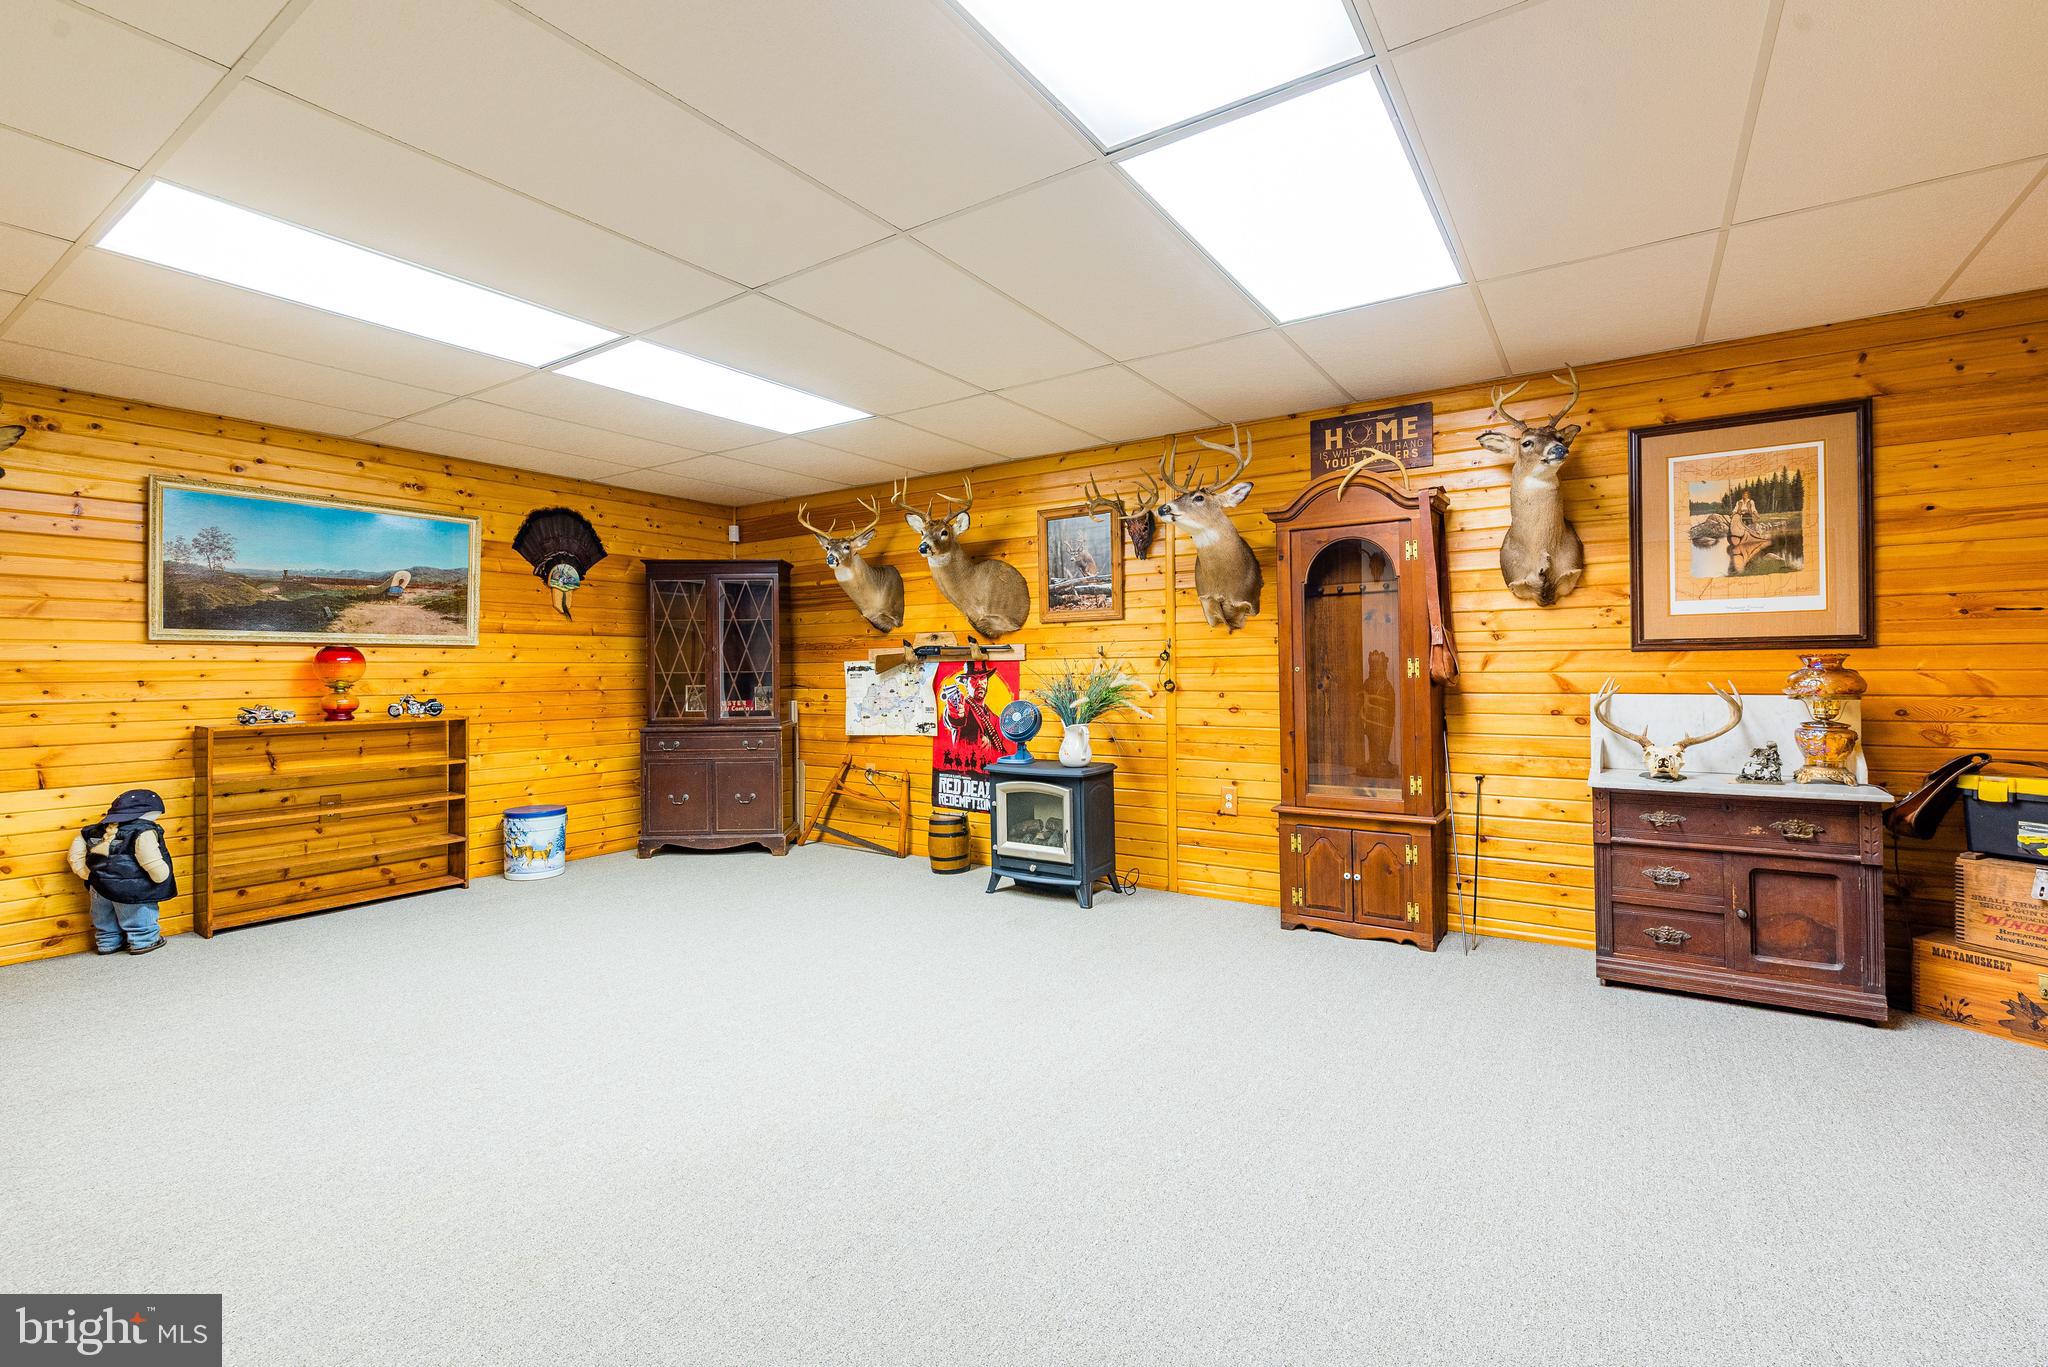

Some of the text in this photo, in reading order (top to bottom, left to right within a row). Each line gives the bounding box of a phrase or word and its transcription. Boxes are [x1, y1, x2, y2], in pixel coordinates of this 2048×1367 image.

[1319, 439, 1424, 461] IS WHER YOU HANG
[1325, 457, 1355, 469] YOUR
[939, 777, 961, 795] RED
[1971, 894, 2010, 906] SMALL
[1979, 902, 2010, 912] SHOT
[2014, 908, 2039, 917] GUN
[1932, 946, 2012, 972] MATTAMUSKEET
